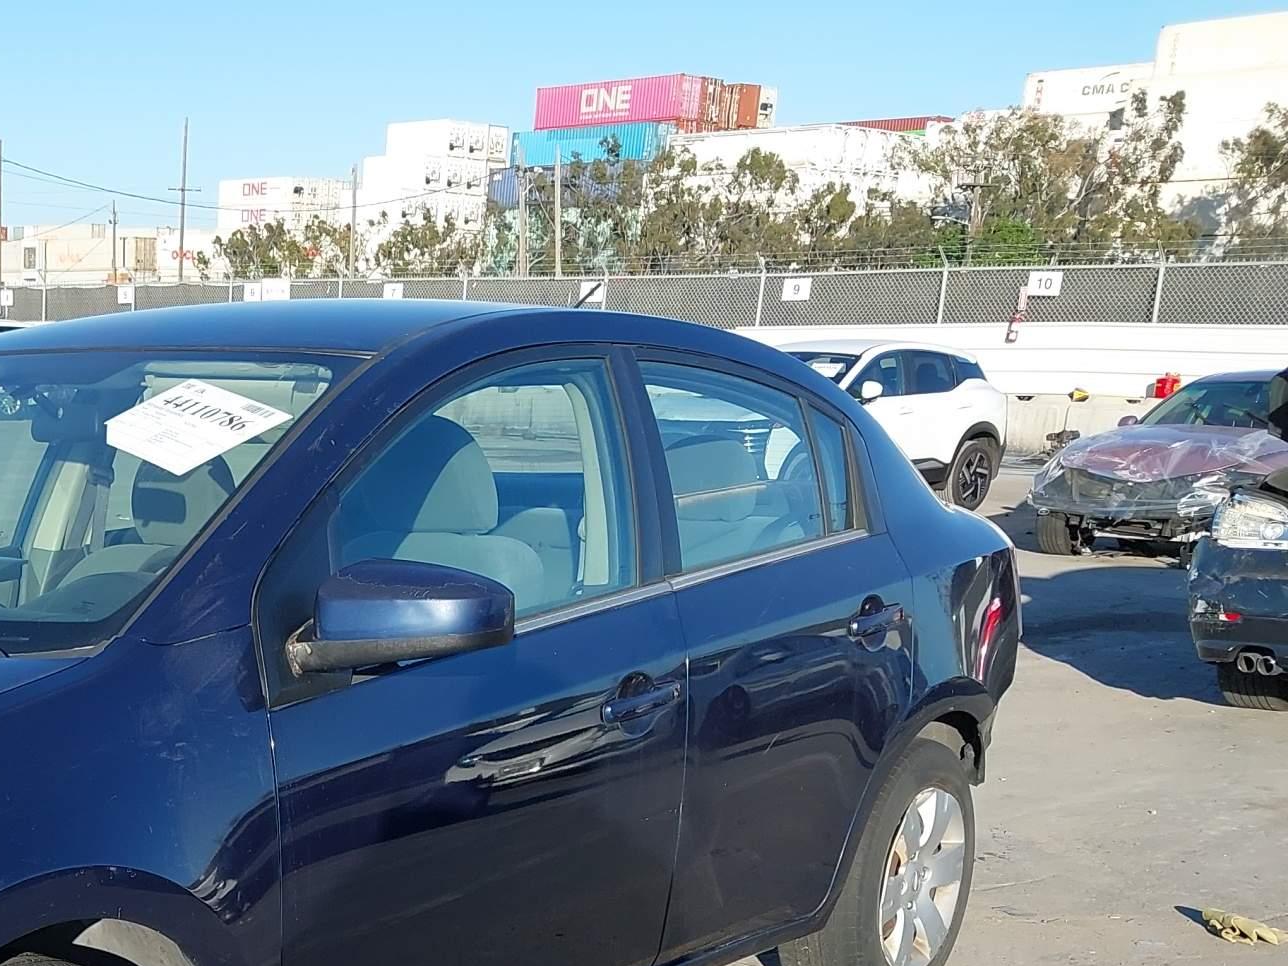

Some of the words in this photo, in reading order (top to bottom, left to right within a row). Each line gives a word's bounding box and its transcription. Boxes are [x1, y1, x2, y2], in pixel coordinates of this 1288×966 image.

[1082, 83, 1114, 96] CMA
[1121, 82, 1130, 93] C
[580, 85, 632, 114] ONE
[243, 182, 268, 197] ONE
[241, 209, 266, 223] ONE
[793, 284, 801, 295] 9
[1037, 278, 1053, 290] 10
[163, 395, 255, 432] 44110786
